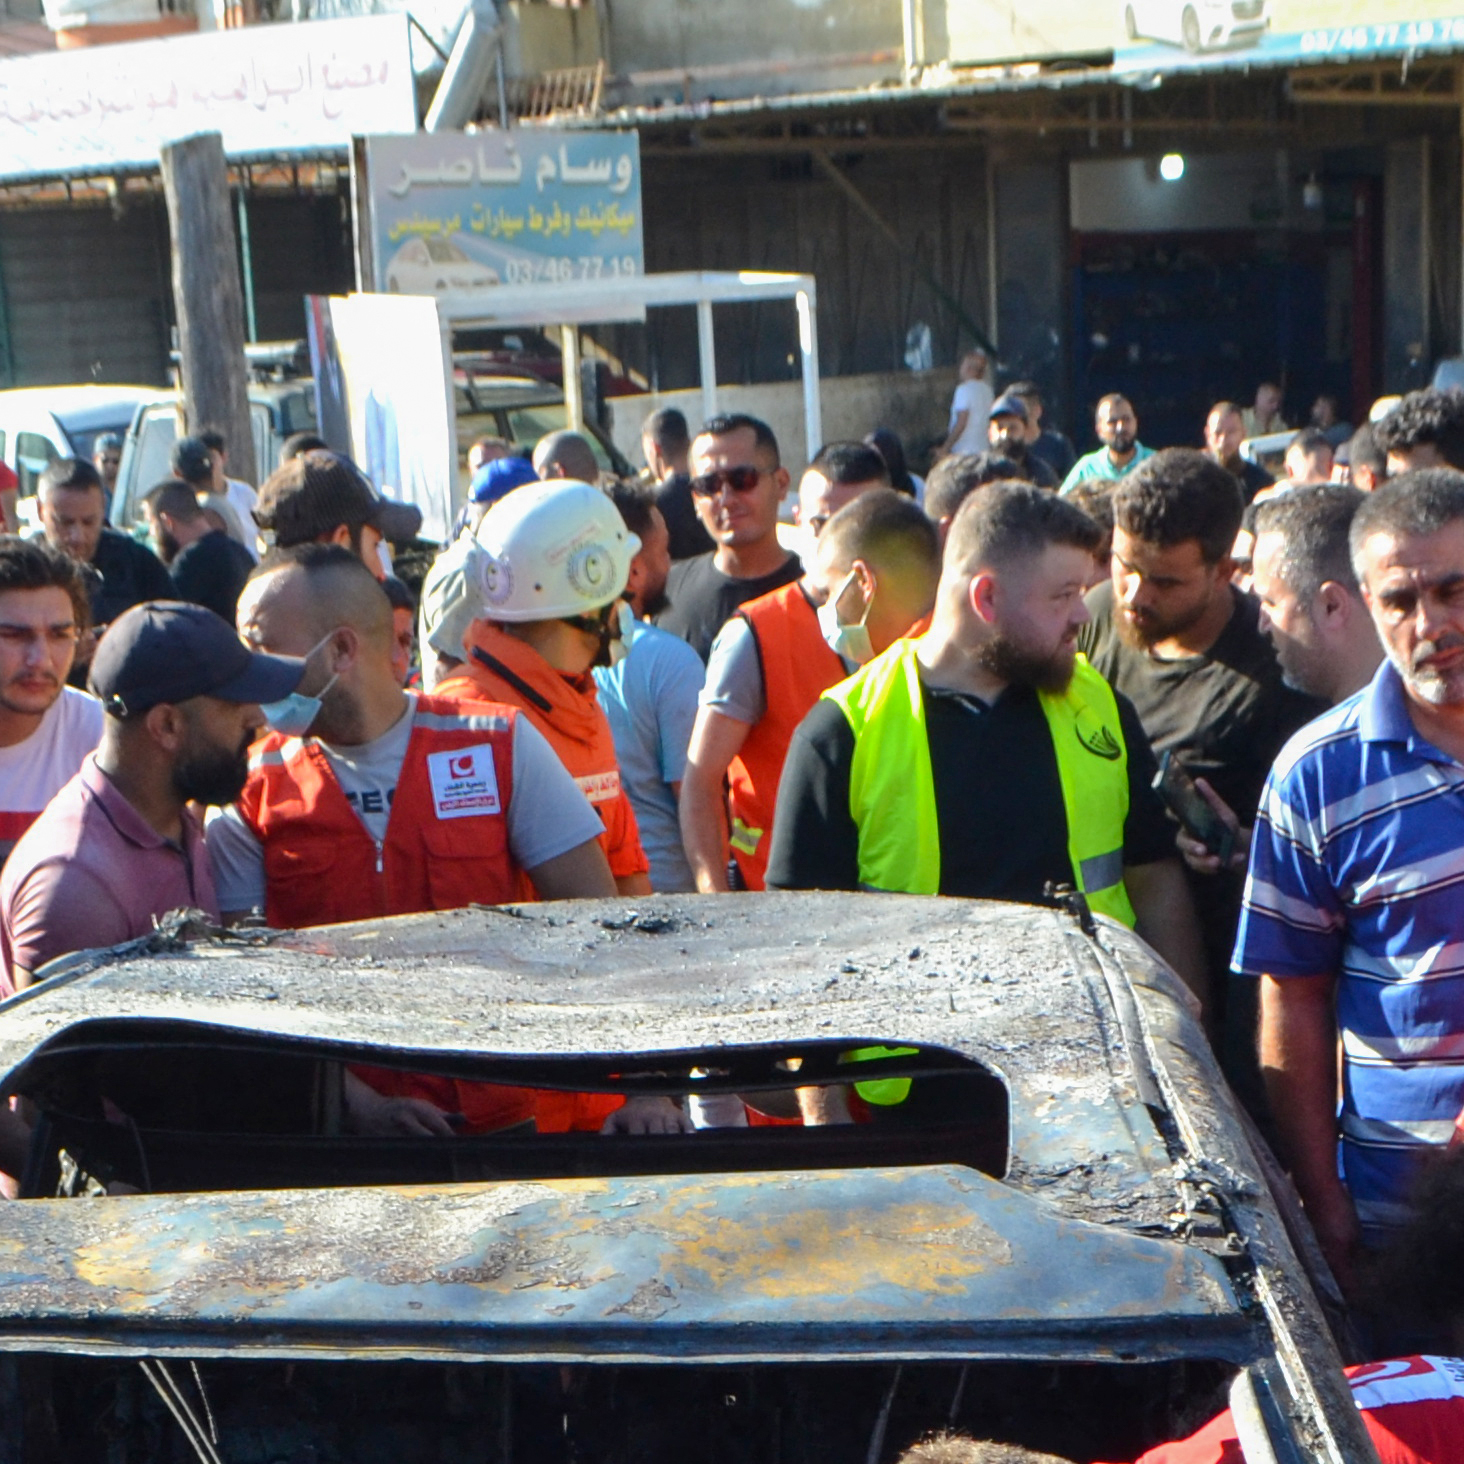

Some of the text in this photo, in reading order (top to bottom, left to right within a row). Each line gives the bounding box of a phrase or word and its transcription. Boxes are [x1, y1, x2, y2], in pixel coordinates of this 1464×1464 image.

[320, 51, 389, 119] مصنع
[388, 139, 633, 197] وسام ناصر
[470, 202, 525, 238] سيارات
[528, 200, 571, 238] وفرط
[575, 201, 635, 238] ميكانيك
[506, 255, 635, 285] 03/46 77 19
